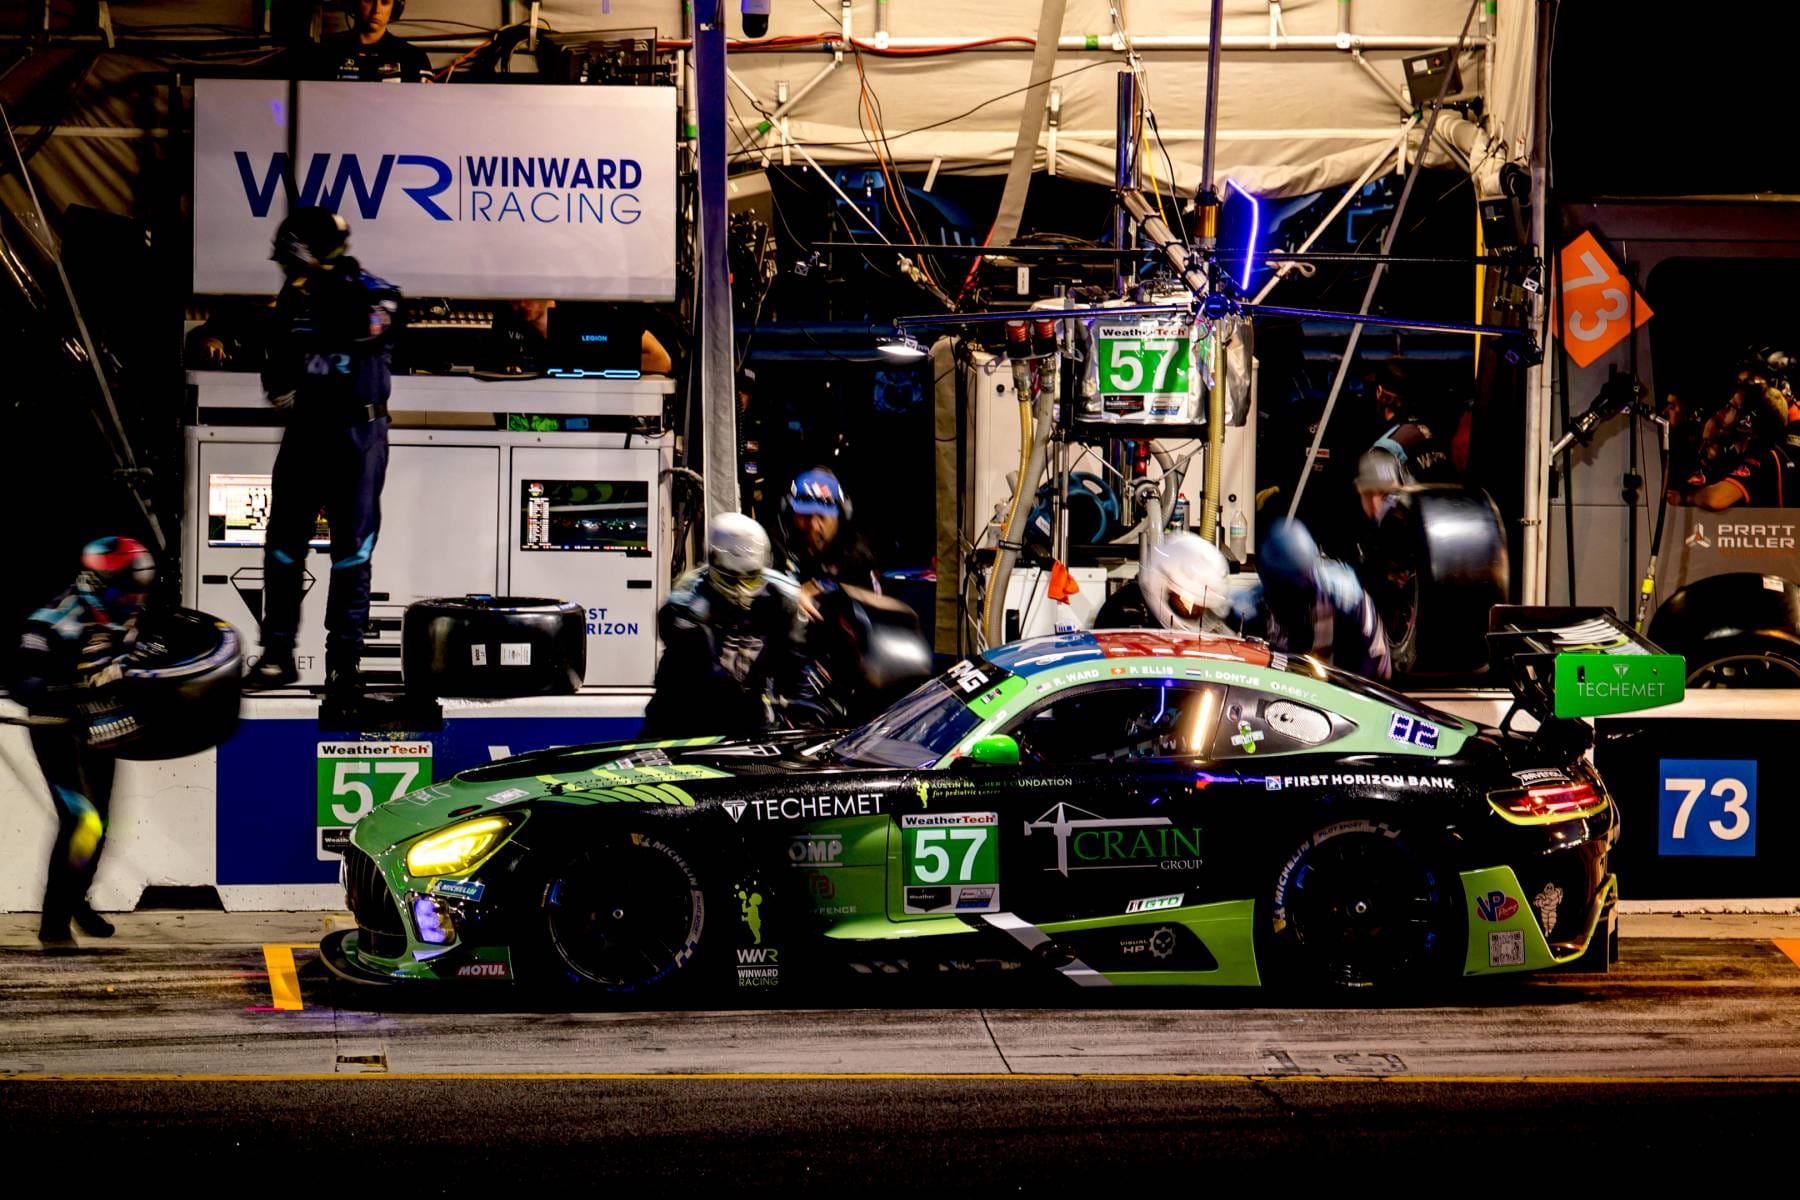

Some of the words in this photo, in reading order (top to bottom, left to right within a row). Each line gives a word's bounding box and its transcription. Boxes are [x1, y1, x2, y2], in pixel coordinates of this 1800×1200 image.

[466, 155, 643, 190] WINWARD
[472, 191, 642, 224] RACING
[1110, 340, 1180, 391] 57
[1717, 524, 1796, 537] PRATT
[1717, 536, 1796, 549] MILLER
[586, 623, 638, 635] RIZON
[1067, 668, 1100, 685] WARD
[1142, 665, 1174, 675] ELLIS
[1215, 671, 1260, 687] DONTJE
[1576, 681, 1666, 698] TECHEMET
[322, 744, 430, 755] WeatherTech
[1284, 774, 1329, 788] FIRST
[1331, 773, 1406, 788] HORIZON
[1408, 775, 1455, 790] BANK
[331, 761, 420, 824] 57
[751, 793, 885, 821] TECHEMET
[1665, 778, 1751, 841] 73
[905, 814, 995, 826] WeatherTech
[787, 839, 843, 862] OMP
[1073, 827, 1203, 861] CRAIN
[652, 840, 700, 887] MICHELIN
[914, 828, 989, 884] 57
[1160, 859, 1203, 870] GROUP
[1274, 840, 1311, 905] MICHELIN
[1145, 896, 1179, 909] GTD
[1476, 890, 1505, 921] VP
[736, 948, 779, 963] WWR
[1123, 945, 1145, 954] HP
[458, 964, 506, 976] MOTUL
[738, 968, 779, 978] WINWARD
[738, 977, 779, 987] RACING
